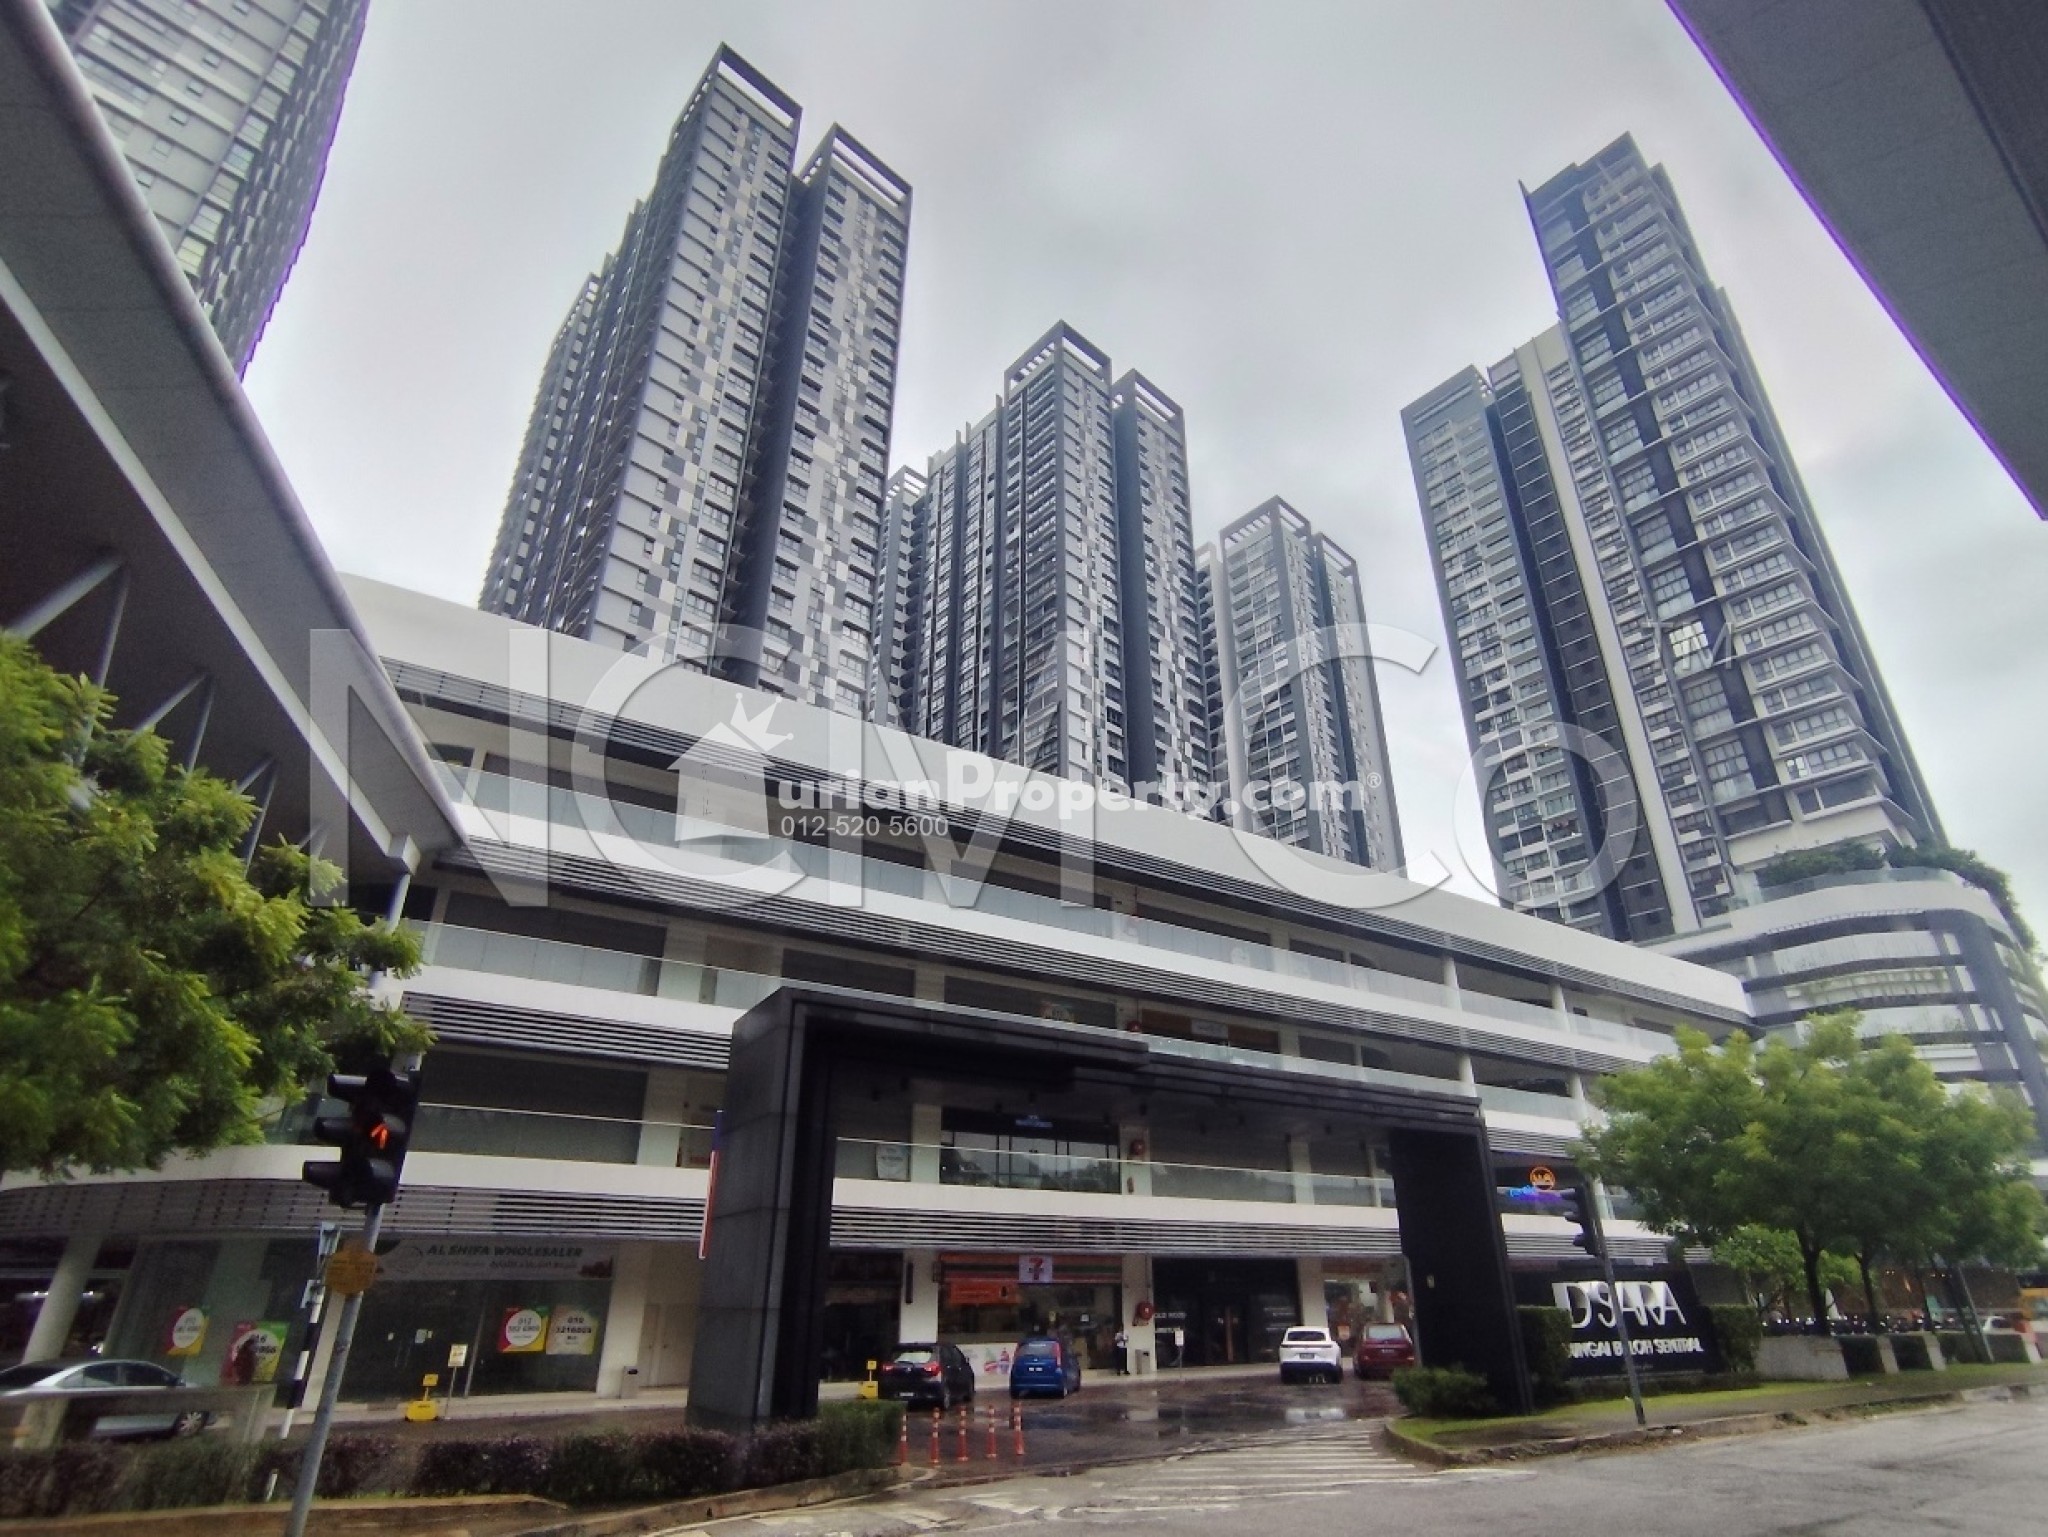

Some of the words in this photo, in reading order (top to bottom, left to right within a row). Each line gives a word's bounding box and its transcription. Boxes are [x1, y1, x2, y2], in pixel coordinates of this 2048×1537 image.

[448, 1245, 490, 1256] SHIFA
[494, 1246, 584, 1258] WHOLESALER
[1612, 1339, 1654, 1357] BLOH
